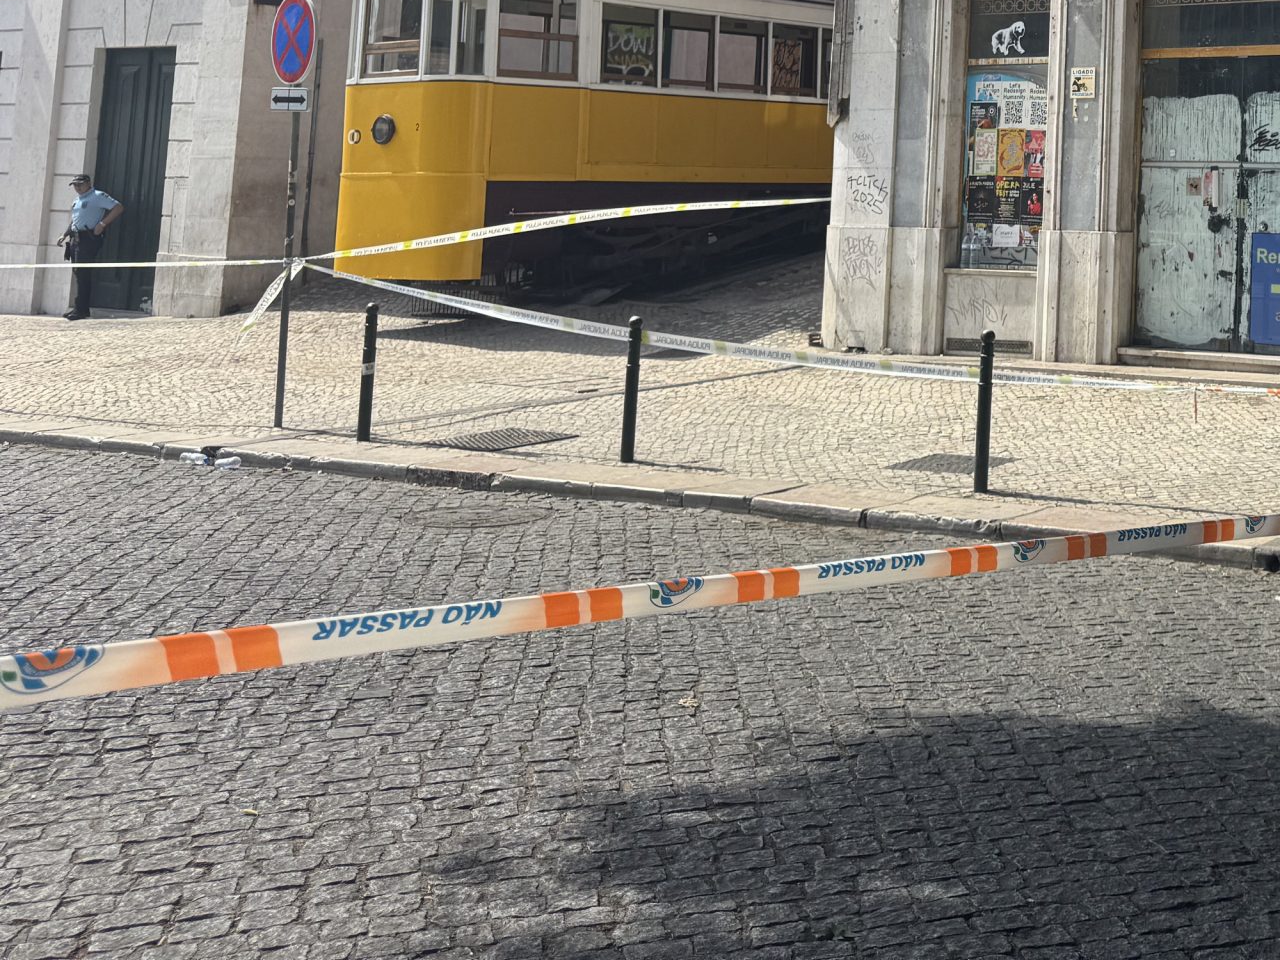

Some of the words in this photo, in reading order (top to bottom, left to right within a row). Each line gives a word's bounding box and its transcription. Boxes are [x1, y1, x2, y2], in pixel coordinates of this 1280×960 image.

[996, 181, 1020, 189] OPERA
[1117, 526, 1162, 542] PASSAR
[1165, 524, 1188, 538] NÃO
[817, 556, 887, 579] PASSAR
[890, 553, 926, 571] NÃO
[441, 600, 502, 626] NÃO
[312, 608, 435, 641] PASSAR
